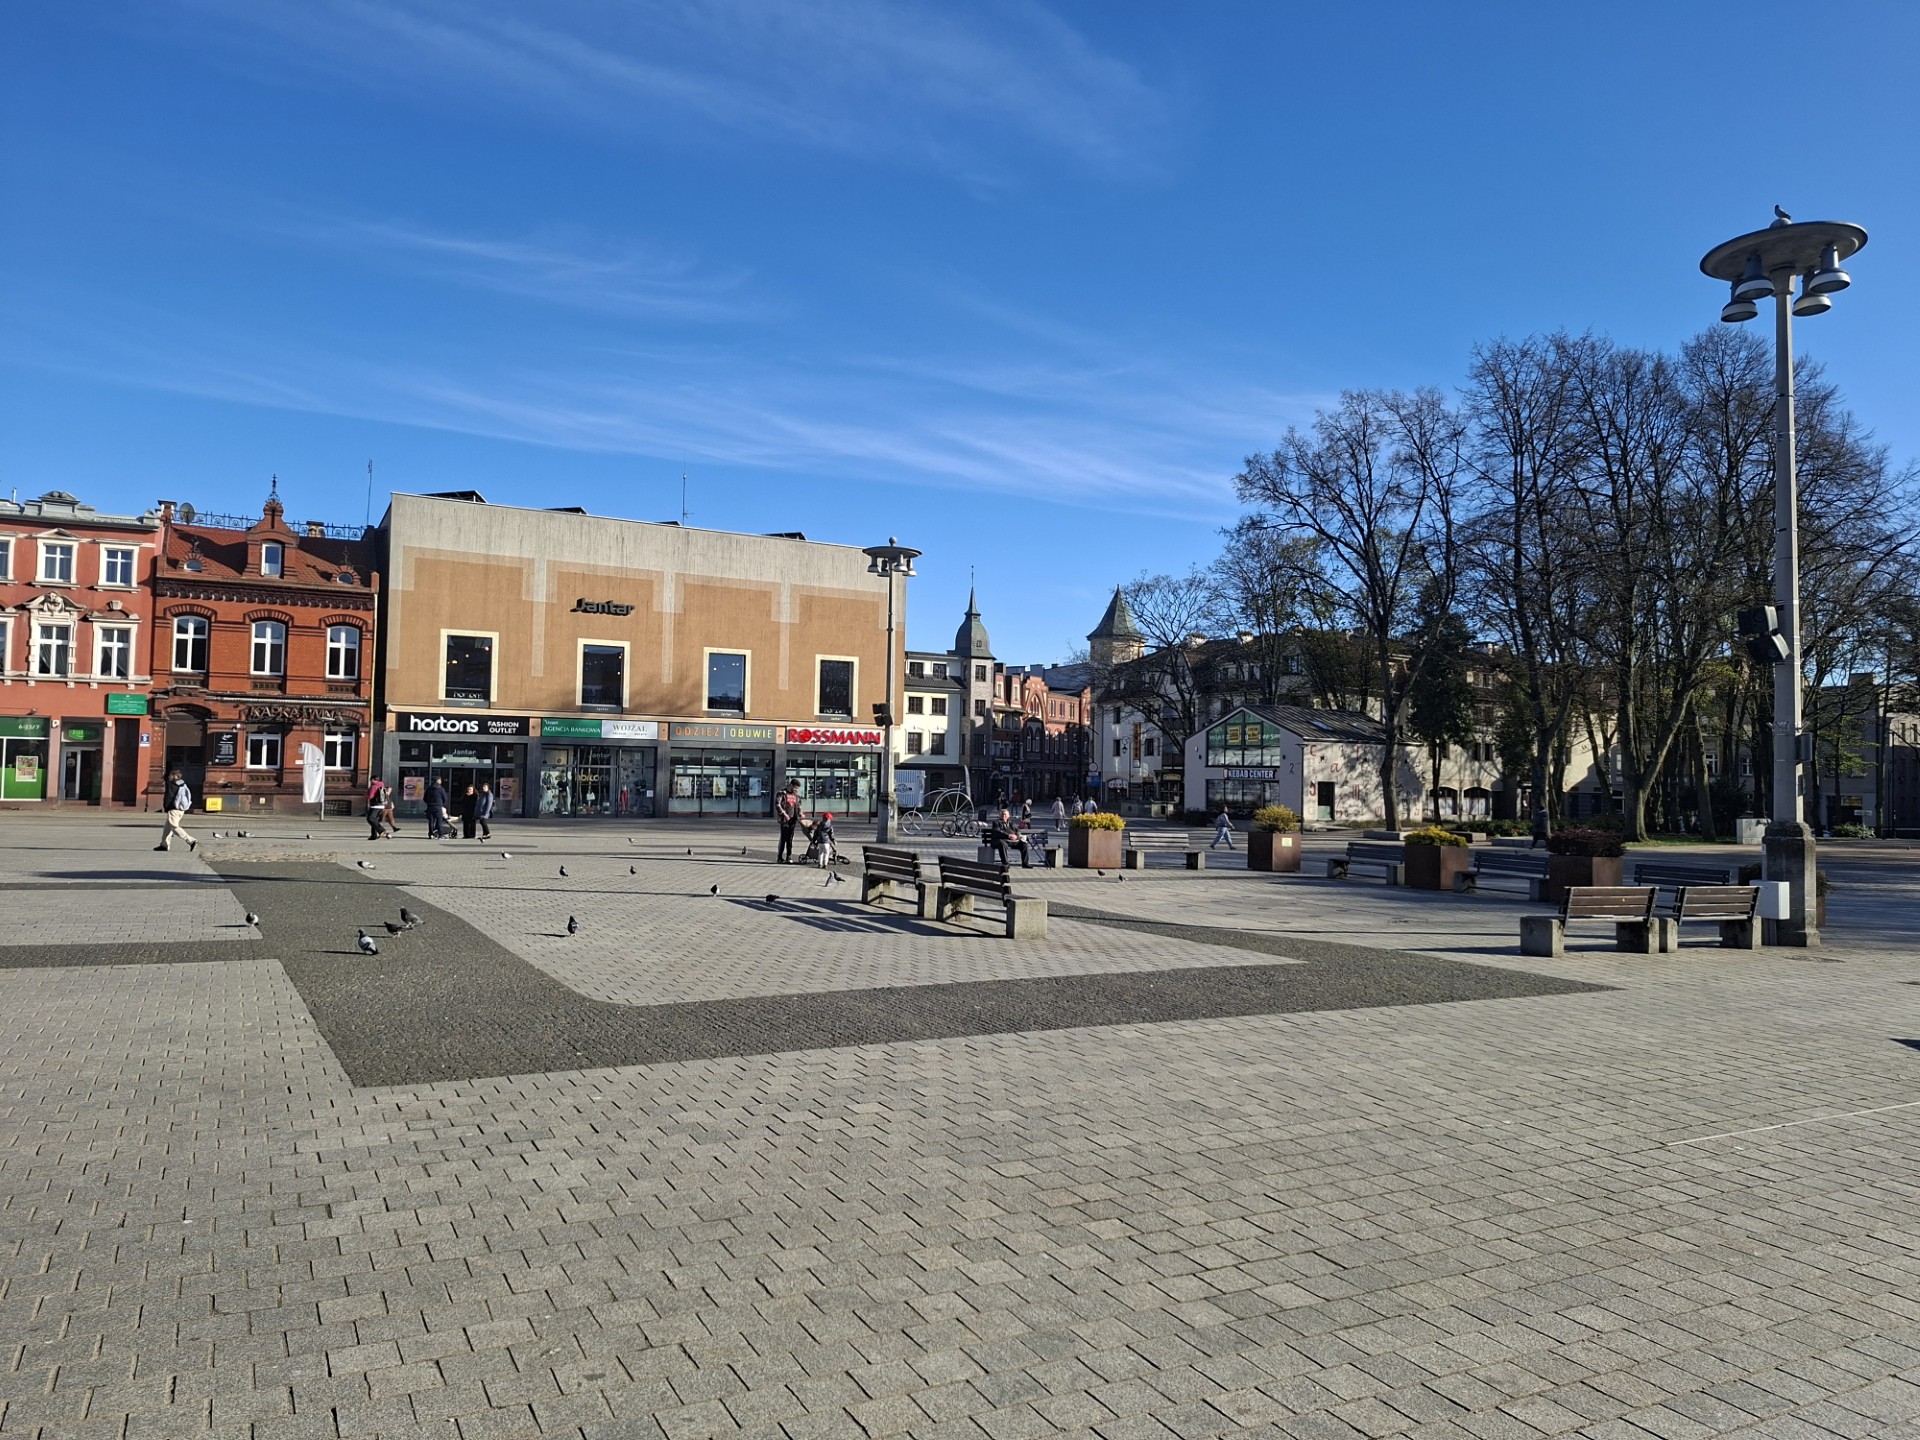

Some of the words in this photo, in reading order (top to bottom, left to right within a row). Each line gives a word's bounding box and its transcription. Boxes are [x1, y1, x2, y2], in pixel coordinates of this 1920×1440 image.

[573, 598, 635, 616] Jantar
[410, 715, 479, 733] hortons
[487, 720, 519, 728] FASHION
[543, 725, 570, 733] AGENCJA
[570, 726, 601, 734] BANKOWA
[729, 727, 772, 739] OBUWIE
[788, 728, 881, 745] ROSSMANN
[1228, 769, 1249, 778] KEBAB
[1249, 770, 1274, 779] CENTER
